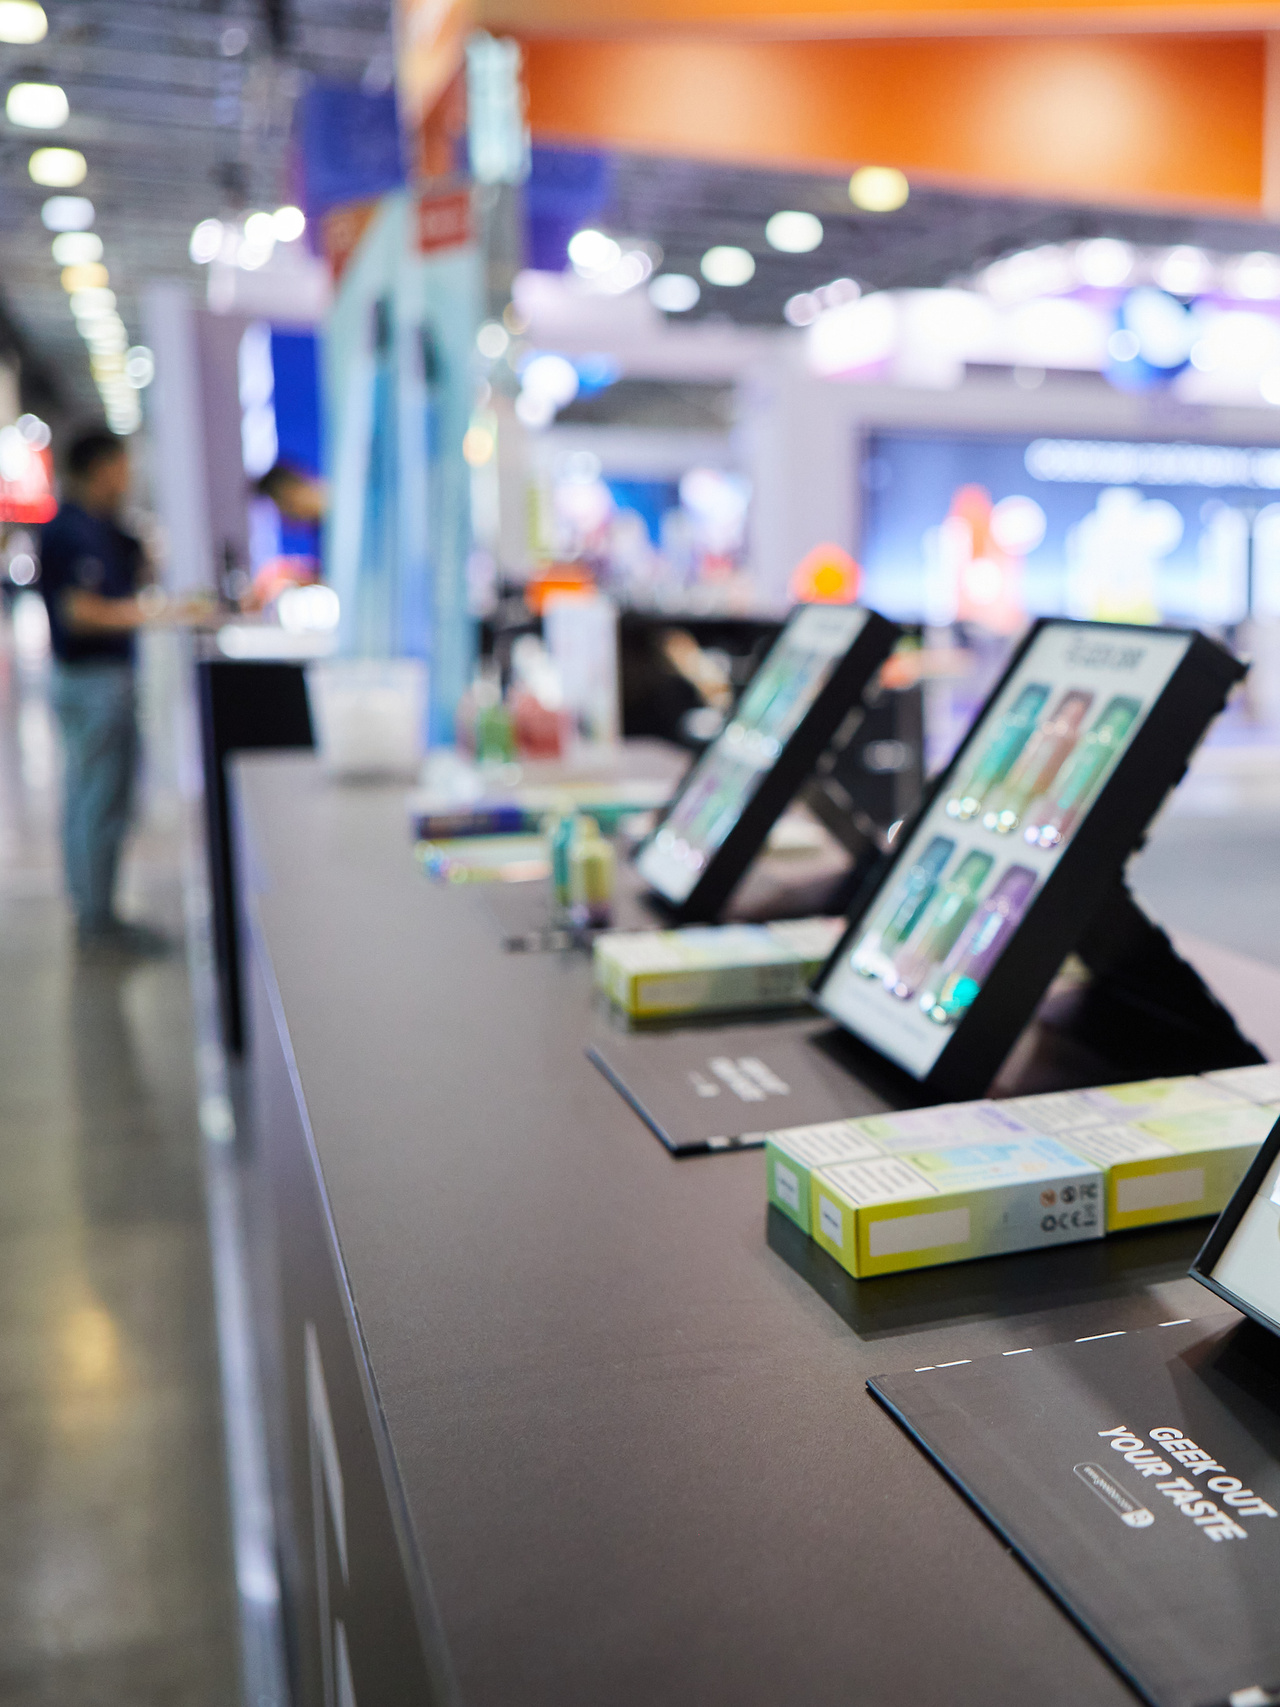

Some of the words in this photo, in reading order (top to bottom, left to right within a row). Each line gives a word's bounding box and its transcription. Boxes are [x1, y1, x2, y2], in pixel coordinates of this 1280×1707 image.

[1098, 1425, 1173, 1478] YOUR
[1155, 1476, 1249, 1542] TASTE
[1149, 1427, 1227, 1476] GEEK
[1207, 1476, 1279, 1518] OUT
